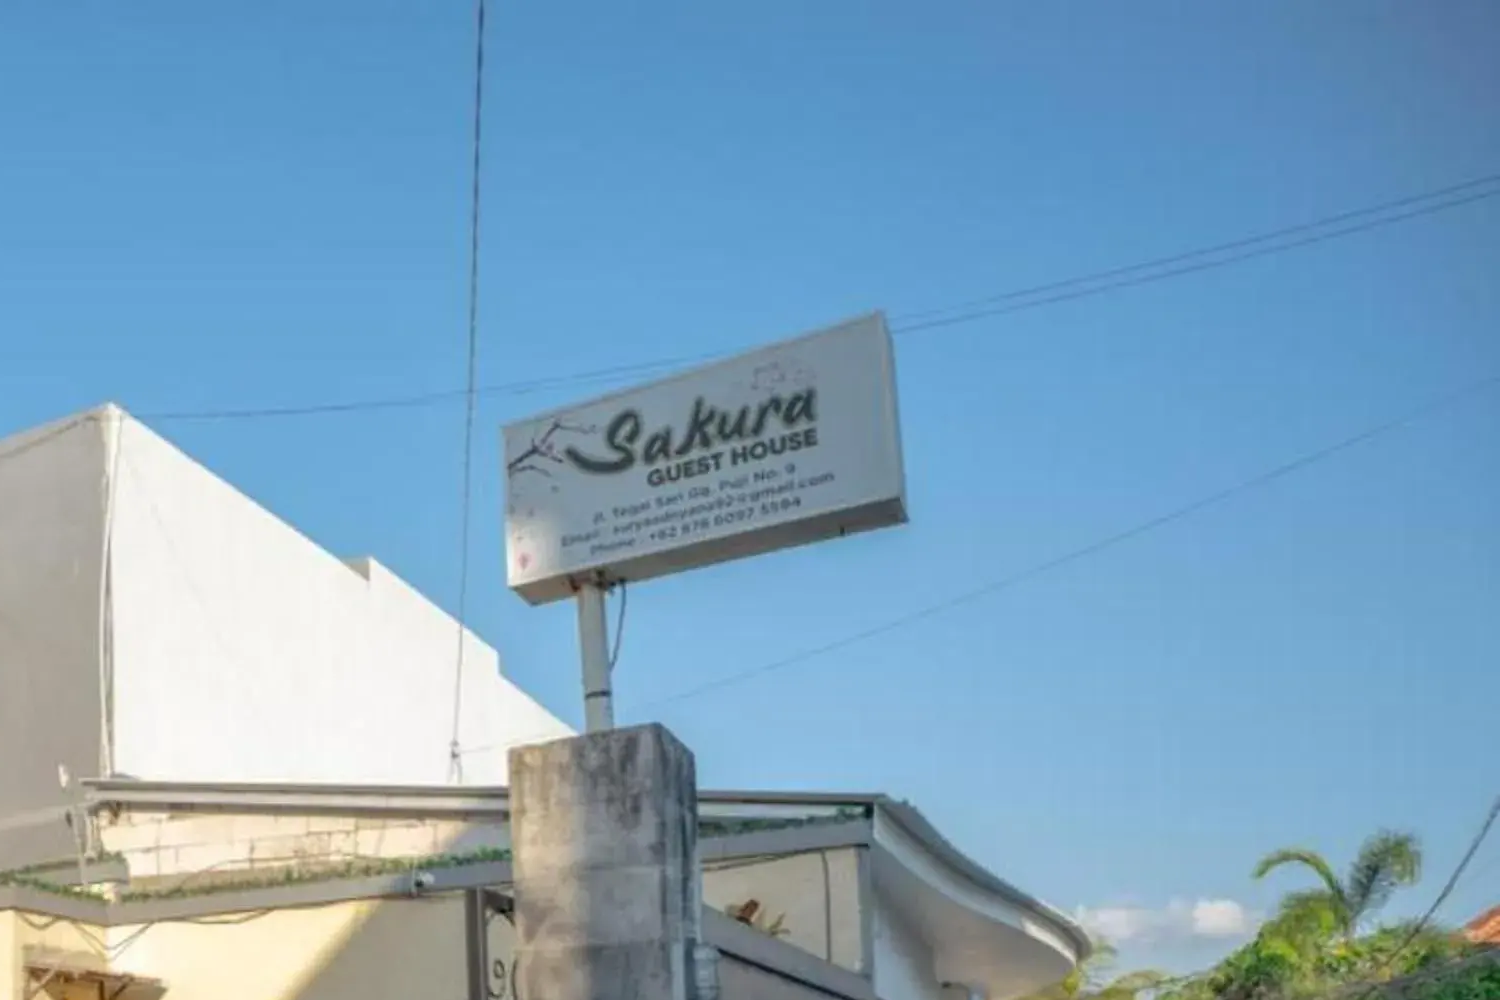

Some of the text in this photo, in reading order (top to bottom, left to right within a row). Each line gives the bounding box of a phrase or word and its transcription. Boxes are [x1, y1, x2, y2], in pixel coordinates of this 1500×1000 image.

[566, 387, 817, 473] Sakura
[647, 428, 819, 487] GUEST HOUSE
